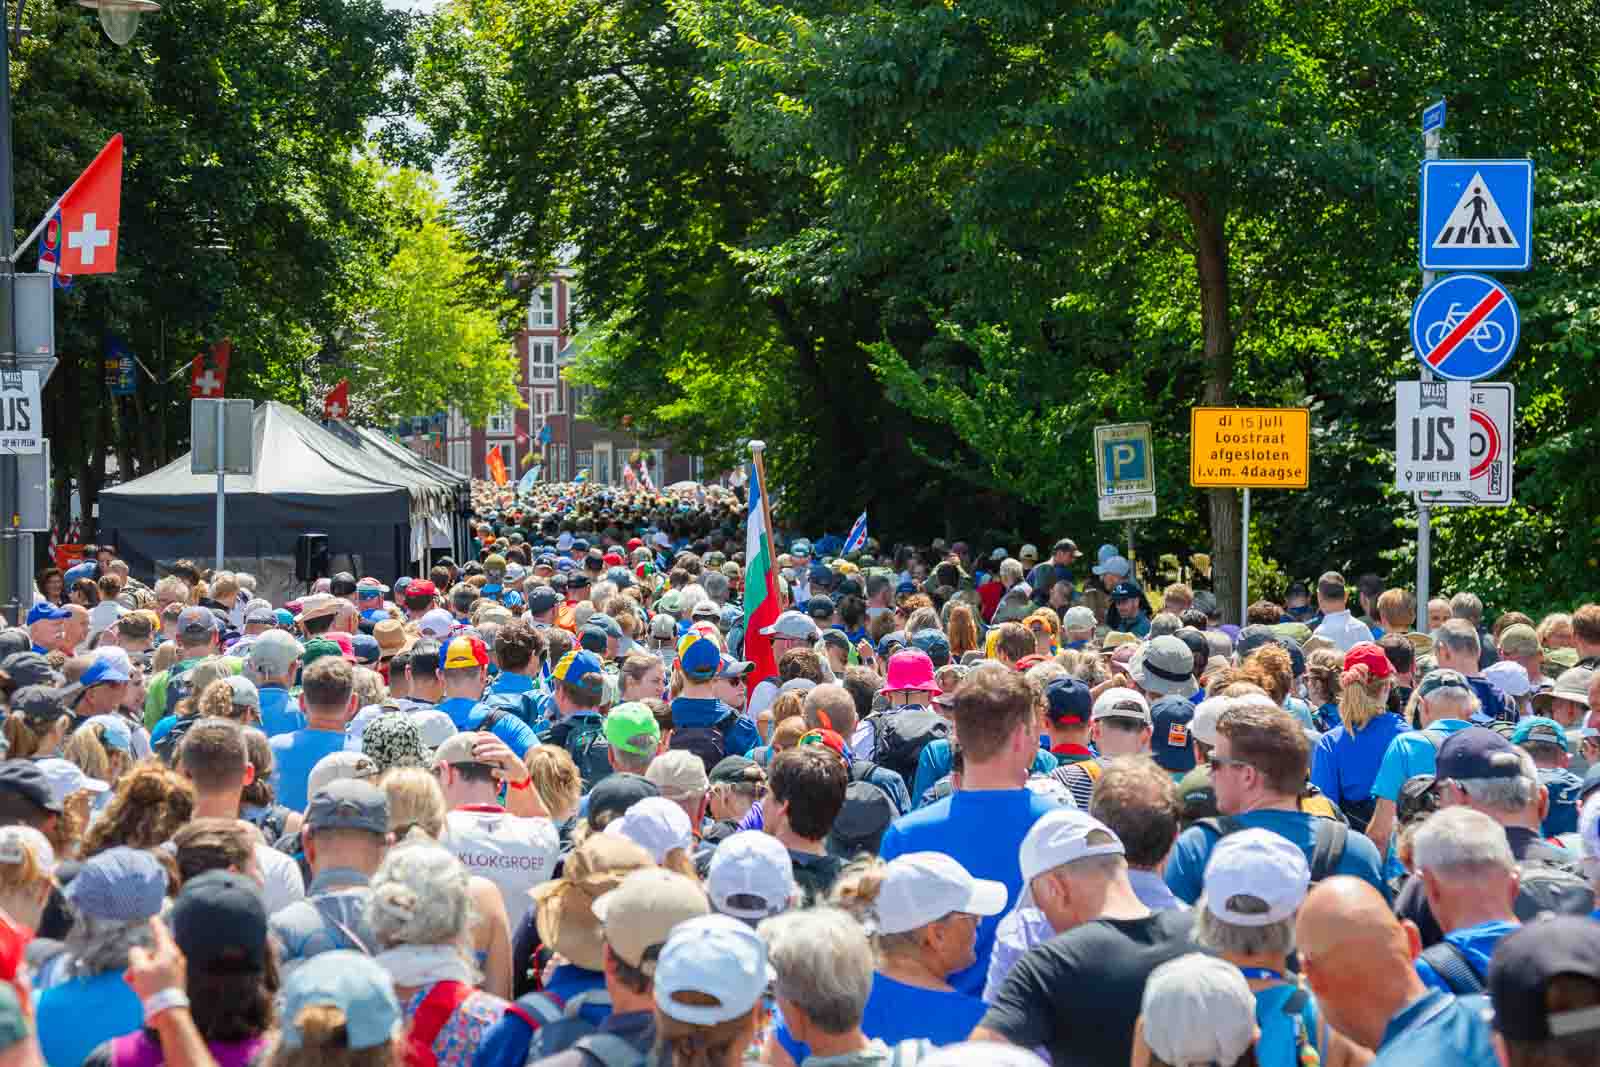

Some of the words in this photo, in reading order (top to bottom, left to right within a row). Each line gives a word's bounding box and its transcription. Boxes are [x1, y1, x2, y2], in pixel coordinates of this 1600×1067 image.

[1219, 415, 1232, 427] di
[1258, 415, 1284, 430] juli
[1215, 431, 1285, 444] Loostraat
[1411, 416, 1455, 462] IJS
[1113, 445, 1135, 480] P
[1210, 448, 1289, 463] afgesloten
[1241, 465, 1302, 480] 4daagse
[1427, 471, 1440, 482] HET
[1441, 471, 1461, 482] PLEIN
[458, 851, 544, 871] KLOKGROEP
